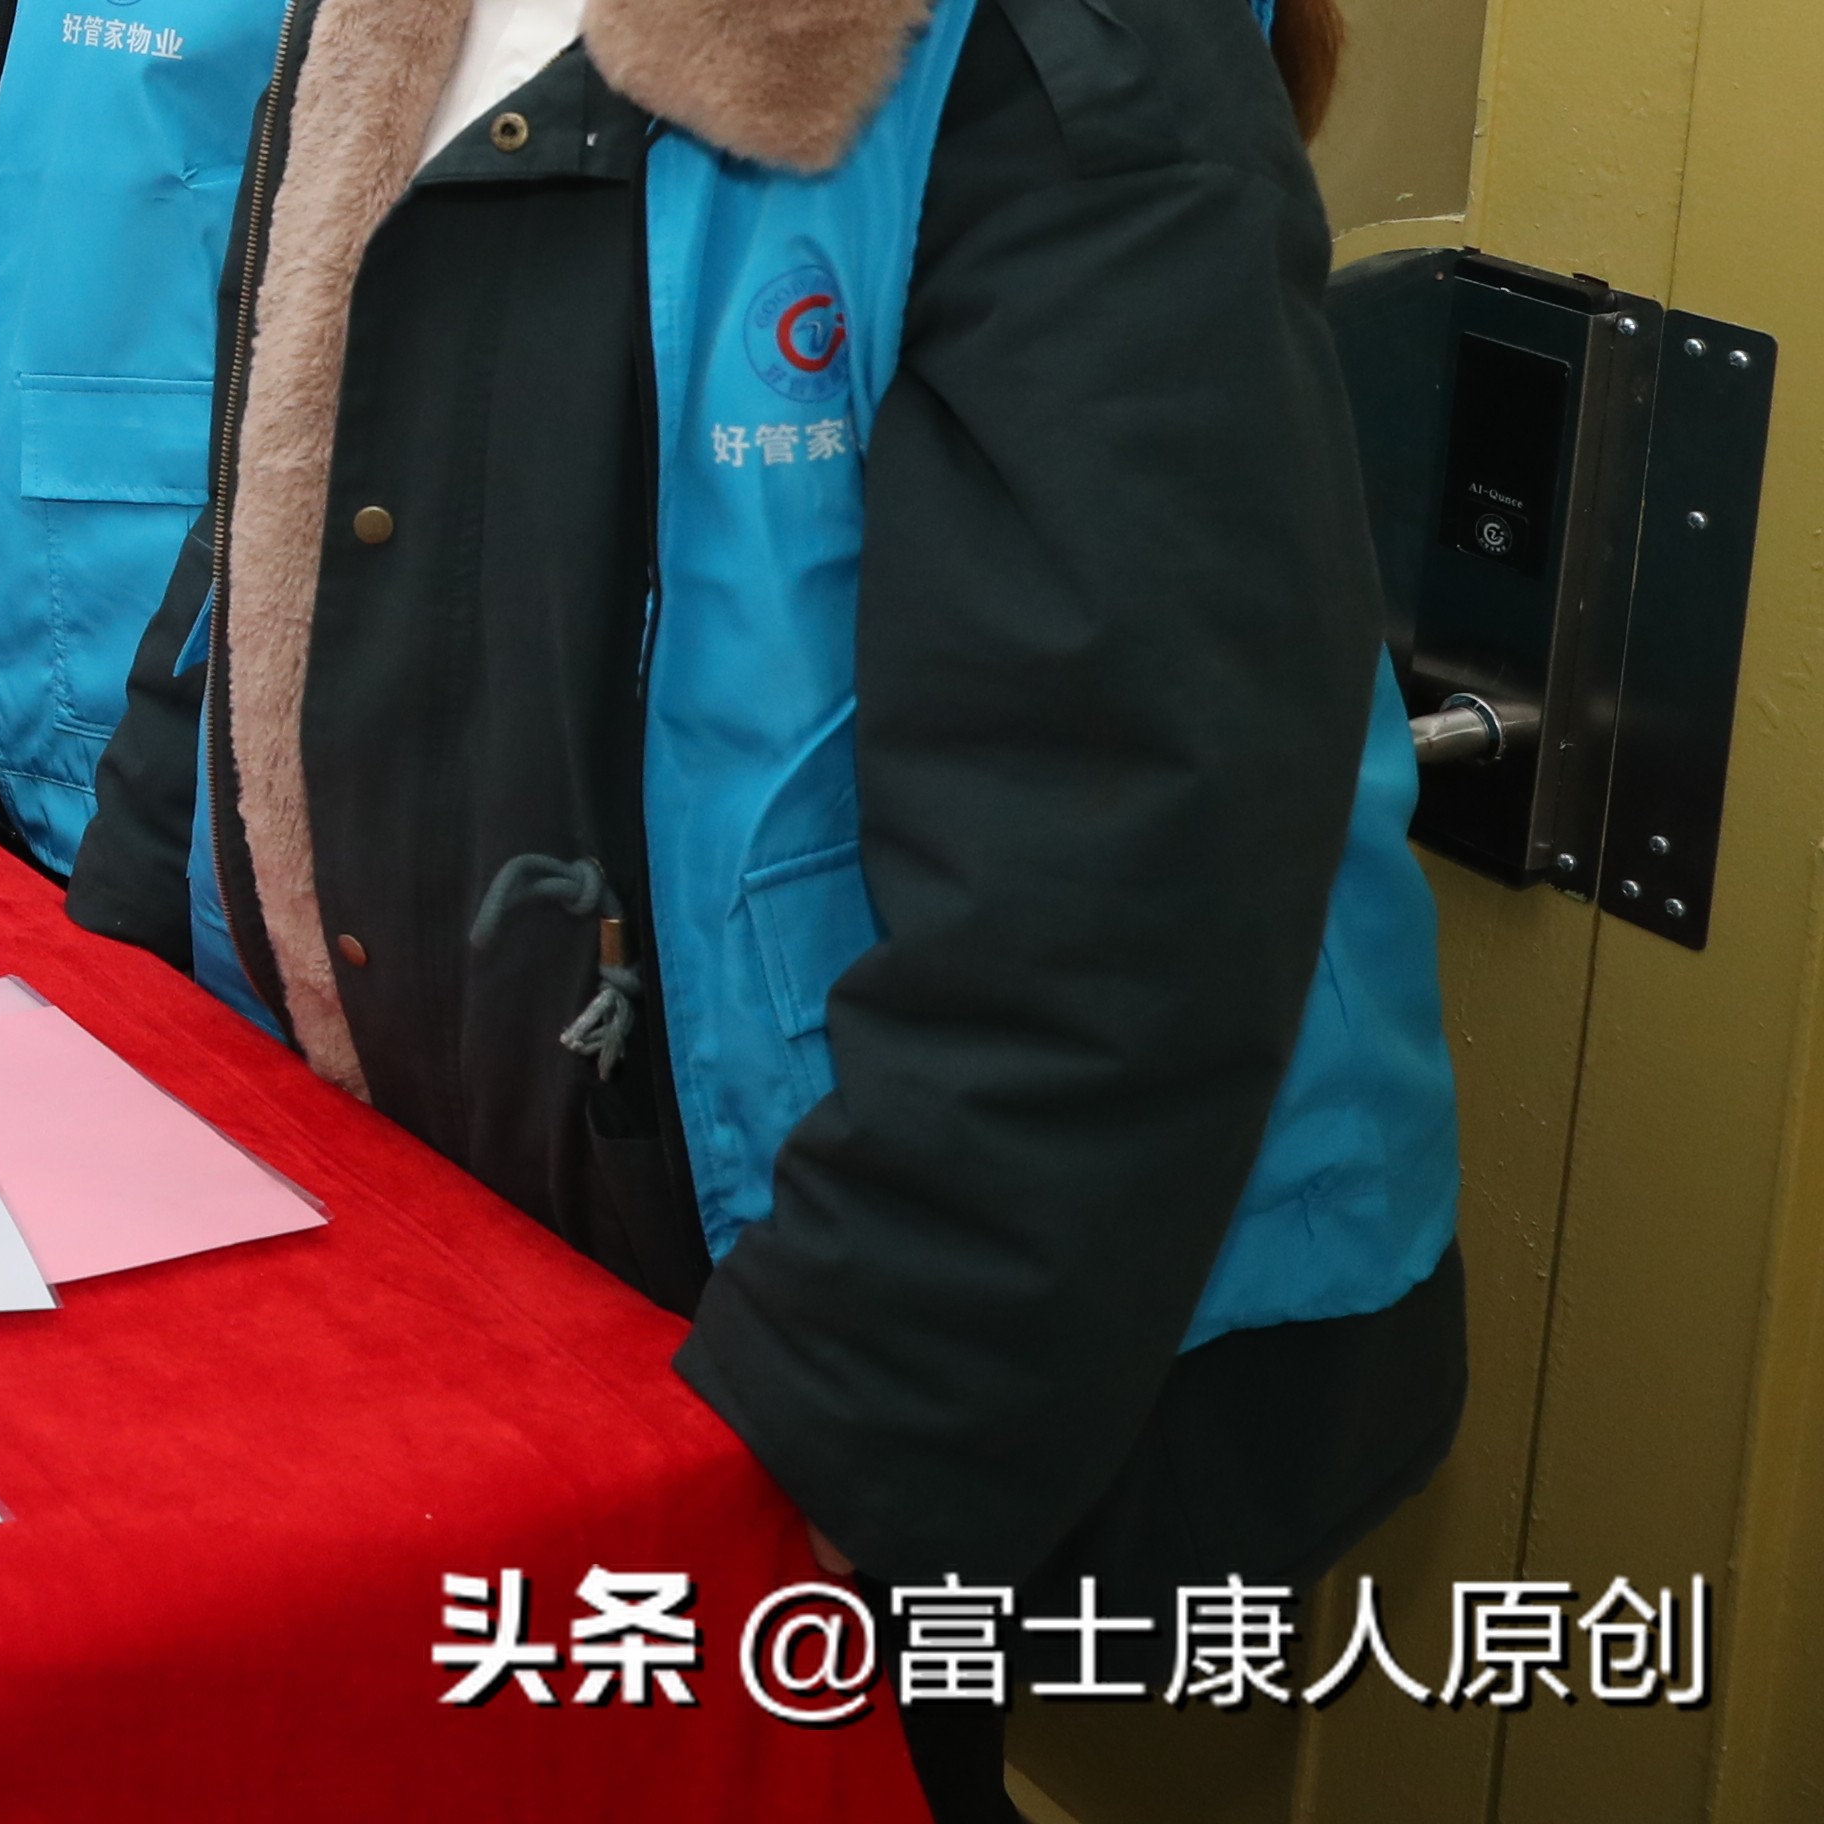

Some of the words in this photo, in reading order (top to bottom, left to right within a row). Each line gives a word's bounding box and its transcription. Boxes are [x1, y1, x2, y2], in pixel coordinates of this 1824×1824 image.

[62, 13, 183, 60] 好管家物业
[711, 417, 866, 468] 好管家
